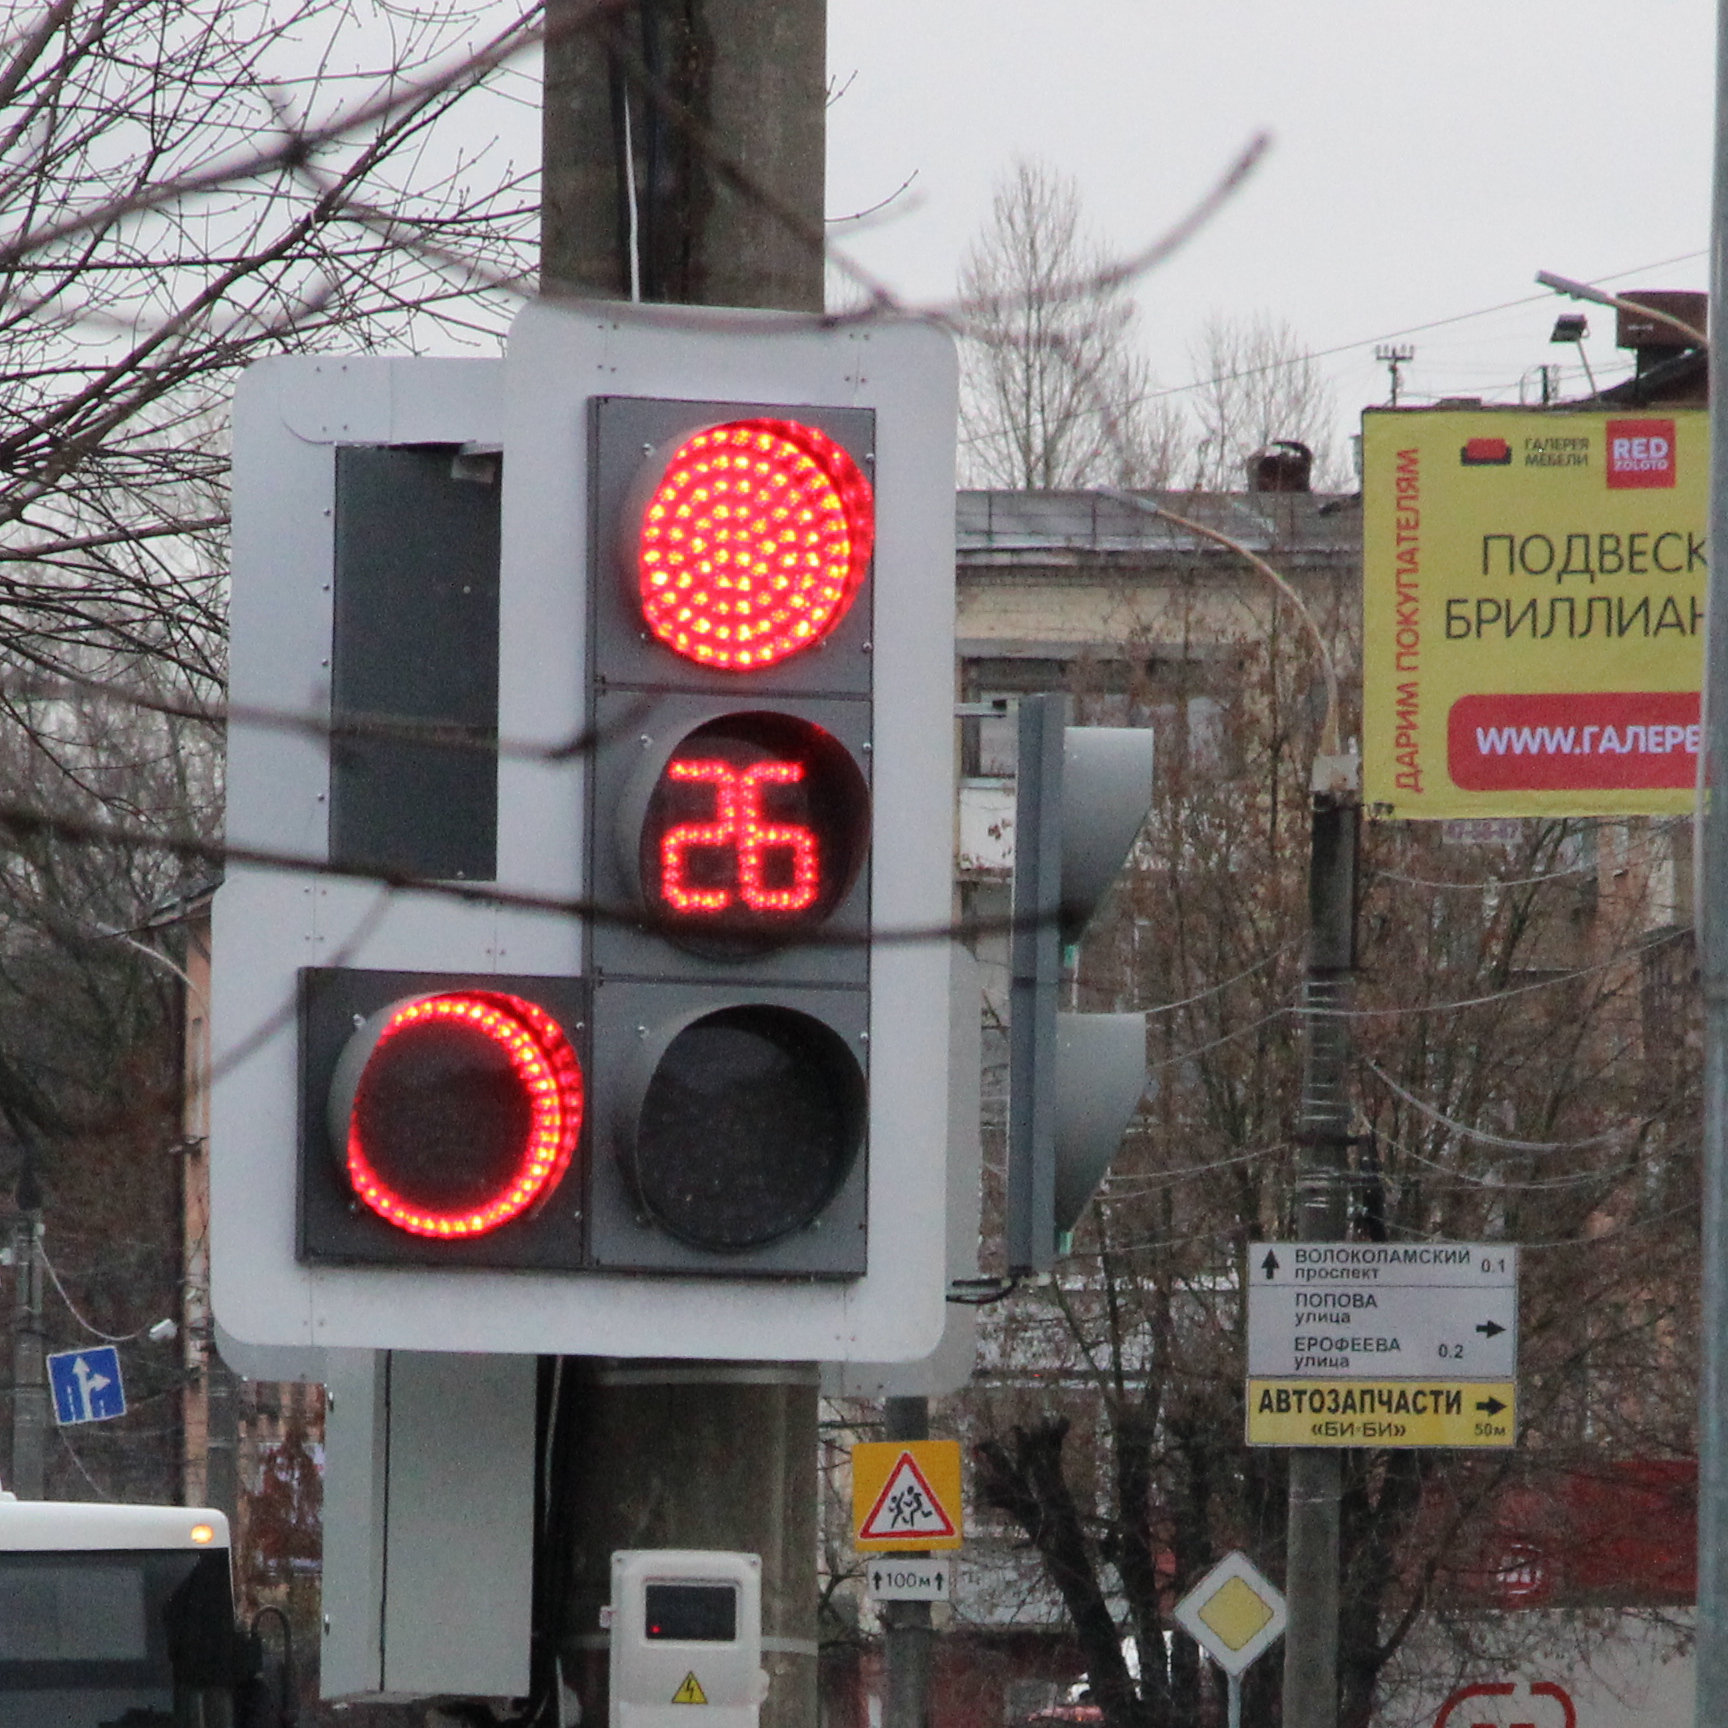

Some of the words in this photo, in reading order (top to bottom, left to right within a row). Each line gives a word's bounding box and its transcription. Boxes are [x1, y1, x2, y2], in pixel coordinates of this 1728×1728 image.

[1524, 437, 1590, 451] ГАЛЕРЕЯ
[1612, 436, 1669, 459] RED
[1524, 453, 1589, 467] МЕБЕЛИ
[1614, 459, 1669, 472] ZOLOTO
[1395, 447, 1422, 673] ПОКУПАТЕЛЯМ
[1395, 680, 1423, 794] ДАРИМ
[1294, 1247, 1472, 1265] ВОЛОКОЛАМСКИЙ
[1480, 1258, 1506, 1274] 0.1
[1294, 1267, 1379, 1281] проспект
[1294, 1293, 1378, 1309] ПОПОВА
[1294, 1311, 1352, 1327] улица
[1293, 1335, 1401, 1353] ЕРОФЕЕВА
[1437, 1343, 1464, 1359] 0.2
[1293, 1354, 1351, 1371] улица
[1258, 1388, 1463, 1415] АВТОЗАПЧАСТИ
[1474, 1424, 1506, 1437] 50м
[886, 1572, 931, 1588] 100м
